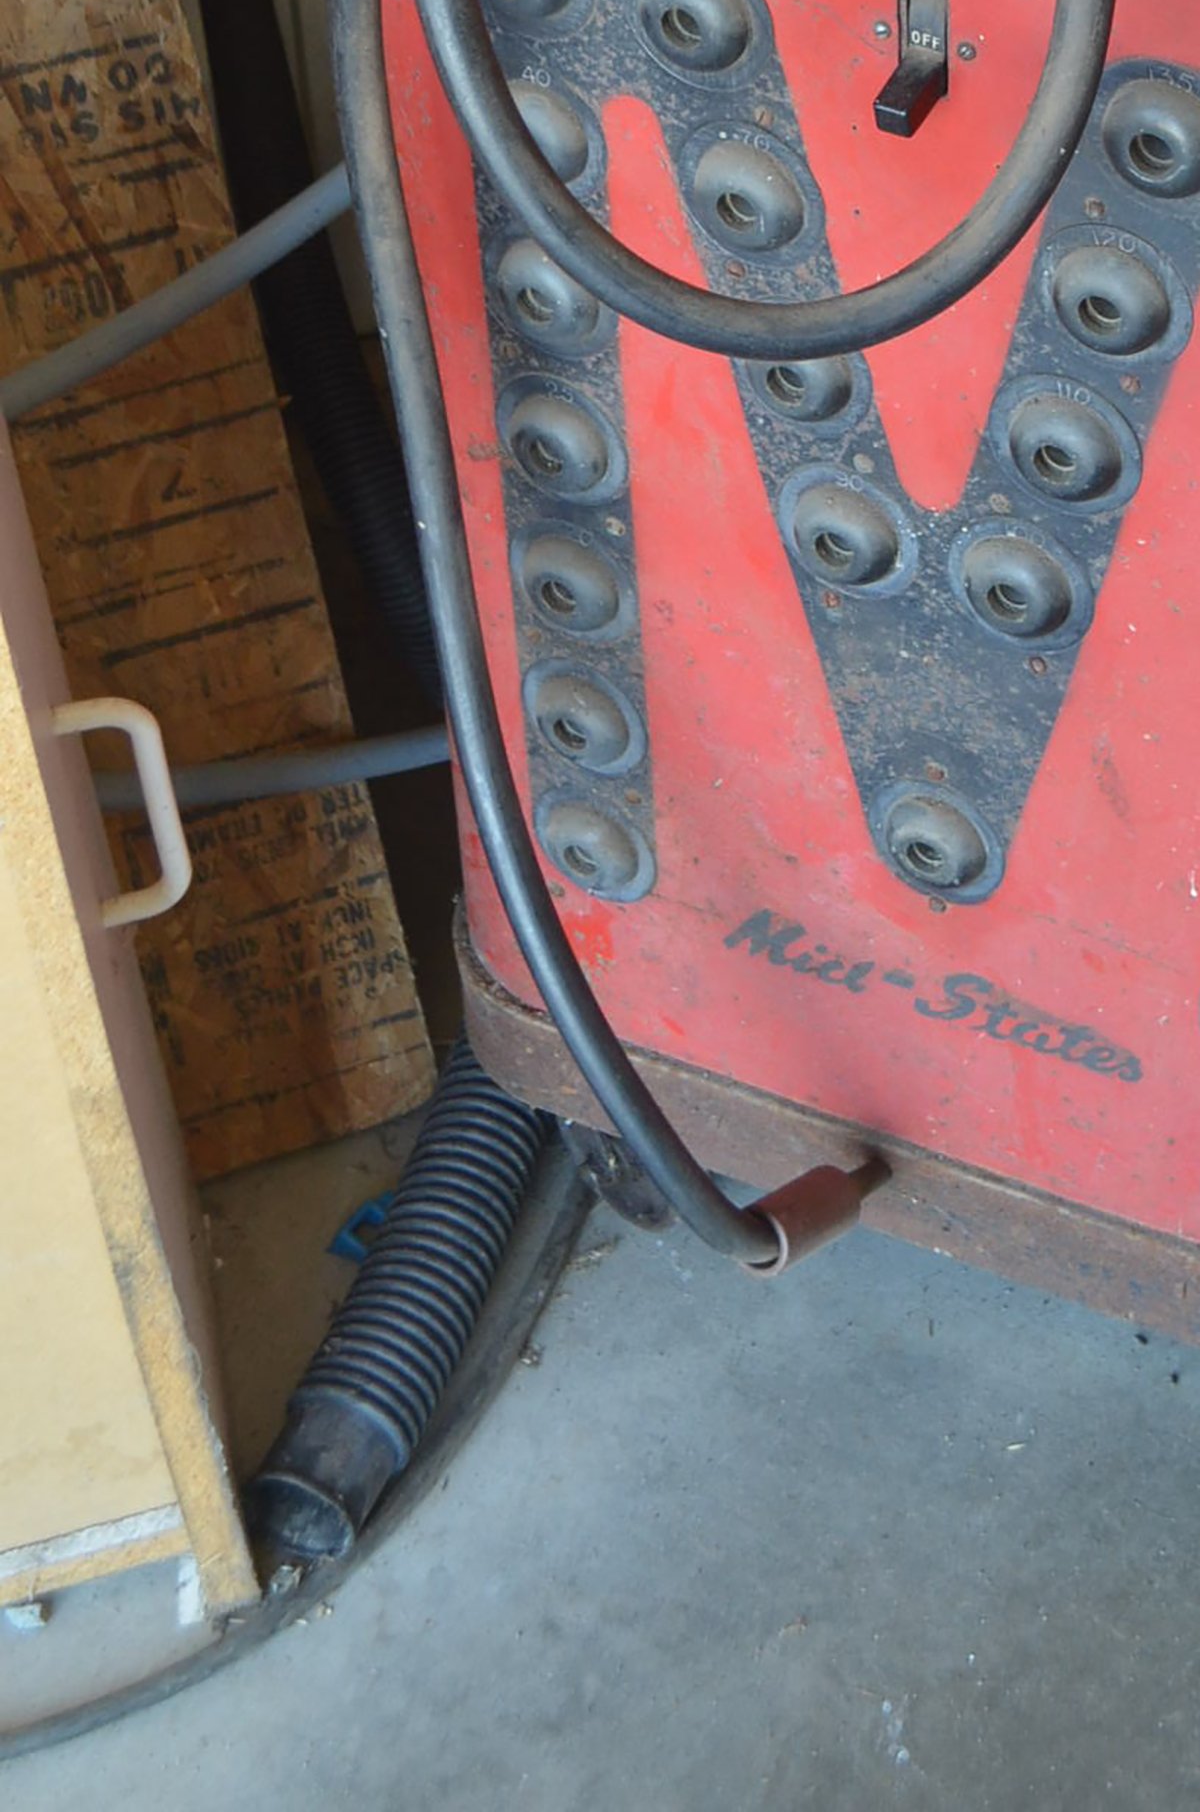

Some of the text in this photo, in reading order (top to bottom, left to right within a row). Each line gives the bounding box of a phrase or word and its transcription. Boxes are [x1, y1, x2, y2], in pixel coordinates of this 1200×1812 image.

[911, 31, 940, 49] OFF
[521, 66, 552, 88] 40
[1057, 378, 1092, 405] 110
[836, 473, 863, 494] 90
